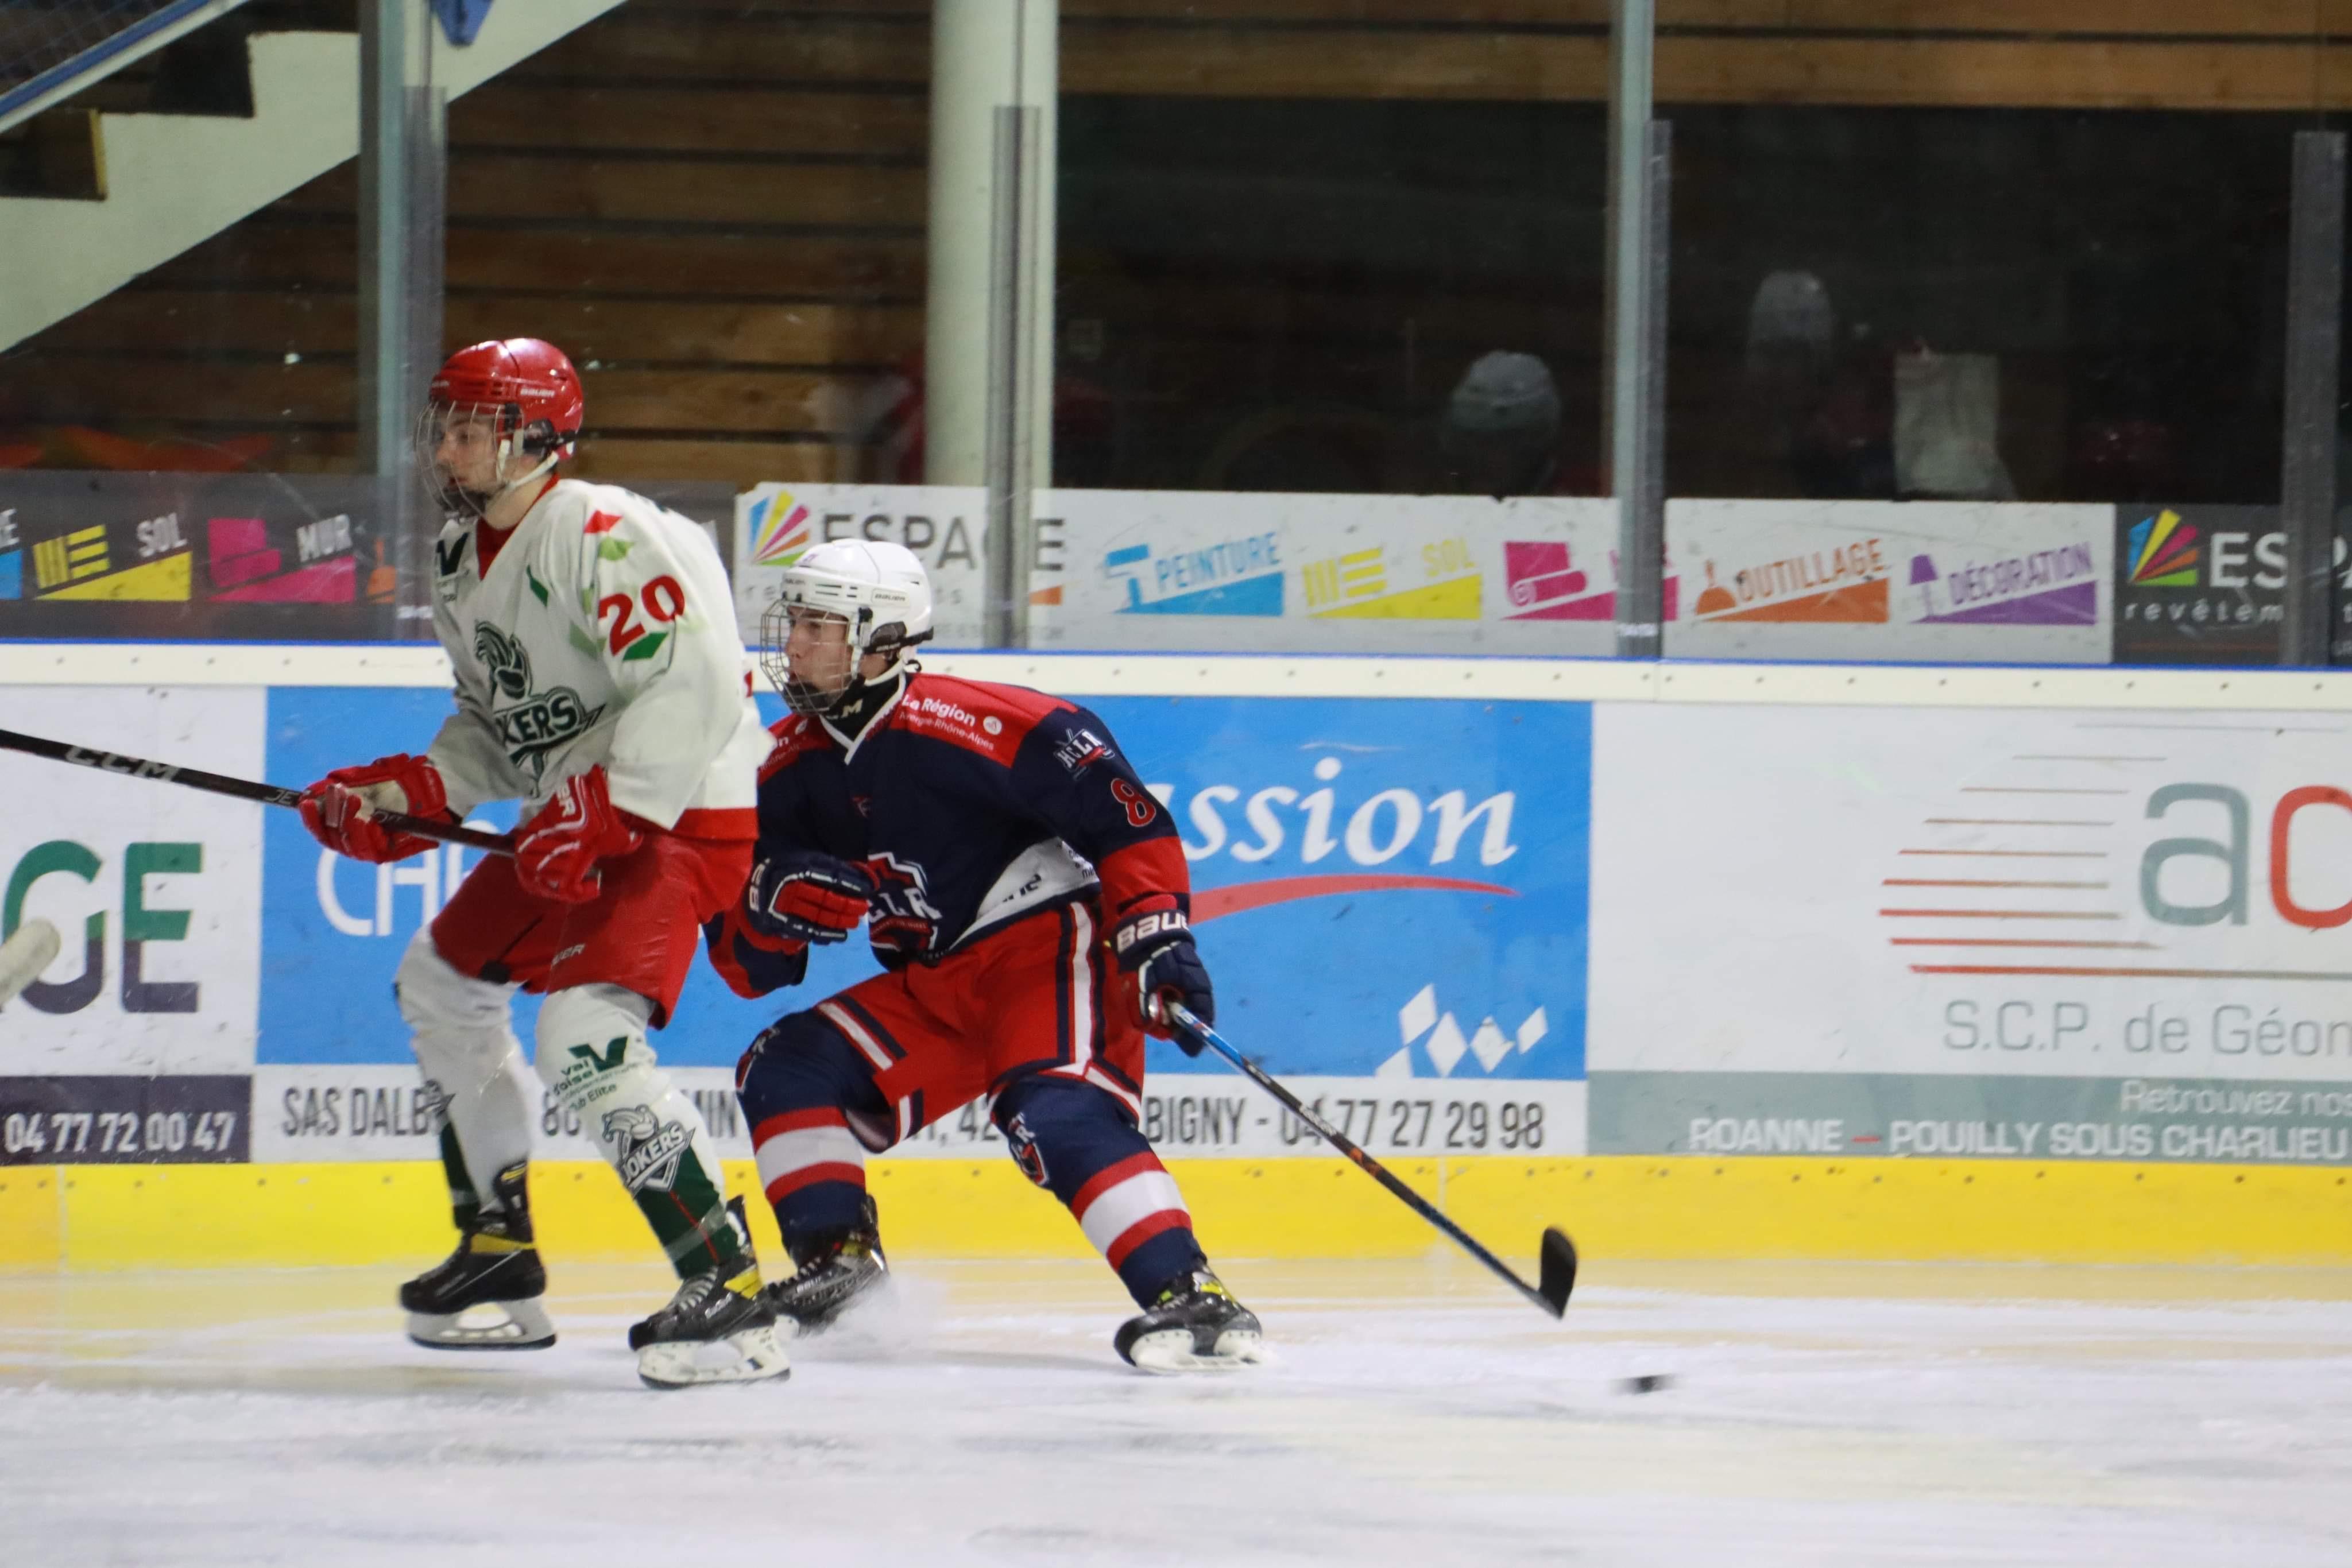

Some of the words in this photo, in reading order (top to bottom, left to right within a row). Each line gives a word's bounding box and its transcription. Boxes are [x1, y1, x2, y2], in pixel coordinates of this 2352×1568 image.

[137, 513, 187, 557] SOL
[297, 514, 353, 562] MUR
[1422, 538, 1475, 575] SOL
[1155, 532, 1281, 592] PEINTURE
[1736, 538, 1887, 602] OUTILLAGE
[1949, 540, 2095, 605] DÉCORATION
[598, 575, 684, 656] 20
[901, 694, 920, 710] La
[921, 698, 976, 727] Région
[64, 745, 181, 783] CCM
[1111, 778, 1156, 827] 8
[1147, 756, 1519, 866] ssion
[1944, 1000, 2102, 1051] S.C.P.
[2125, 1001, 2189, 1054] de
[283, 1086, 337, 1137] SAS
[1147, 1095, 1247, 1145] BIGNY
[1337, 1098, 1379, 1147] 77
[1390, 1099, 1434, 1147] 27
[1446, 1100, 1489, 1148] 29
[1500, 1101, 1545, 1149] 98
[2119, 1079, 2293, 1116] Retrouvez
[4, 1113, 47, 1153] 04
[51, 1112, 94, 1153] 77
[98, 1112, 140, 1152] 72
[145, 1112, 187, 1152] 00
[192, 1111, 237, 1152] 47
[623, 1125, 684, 1179] JOKERS
[1688, 1118, 1845, 1151] ROANNE
[1889, 1120, 2042, 1154] POUILLY
[2048, 1122, 2153, 1156] SOUS
[2160, 1124, 2345, 1159] CHARLIEU
